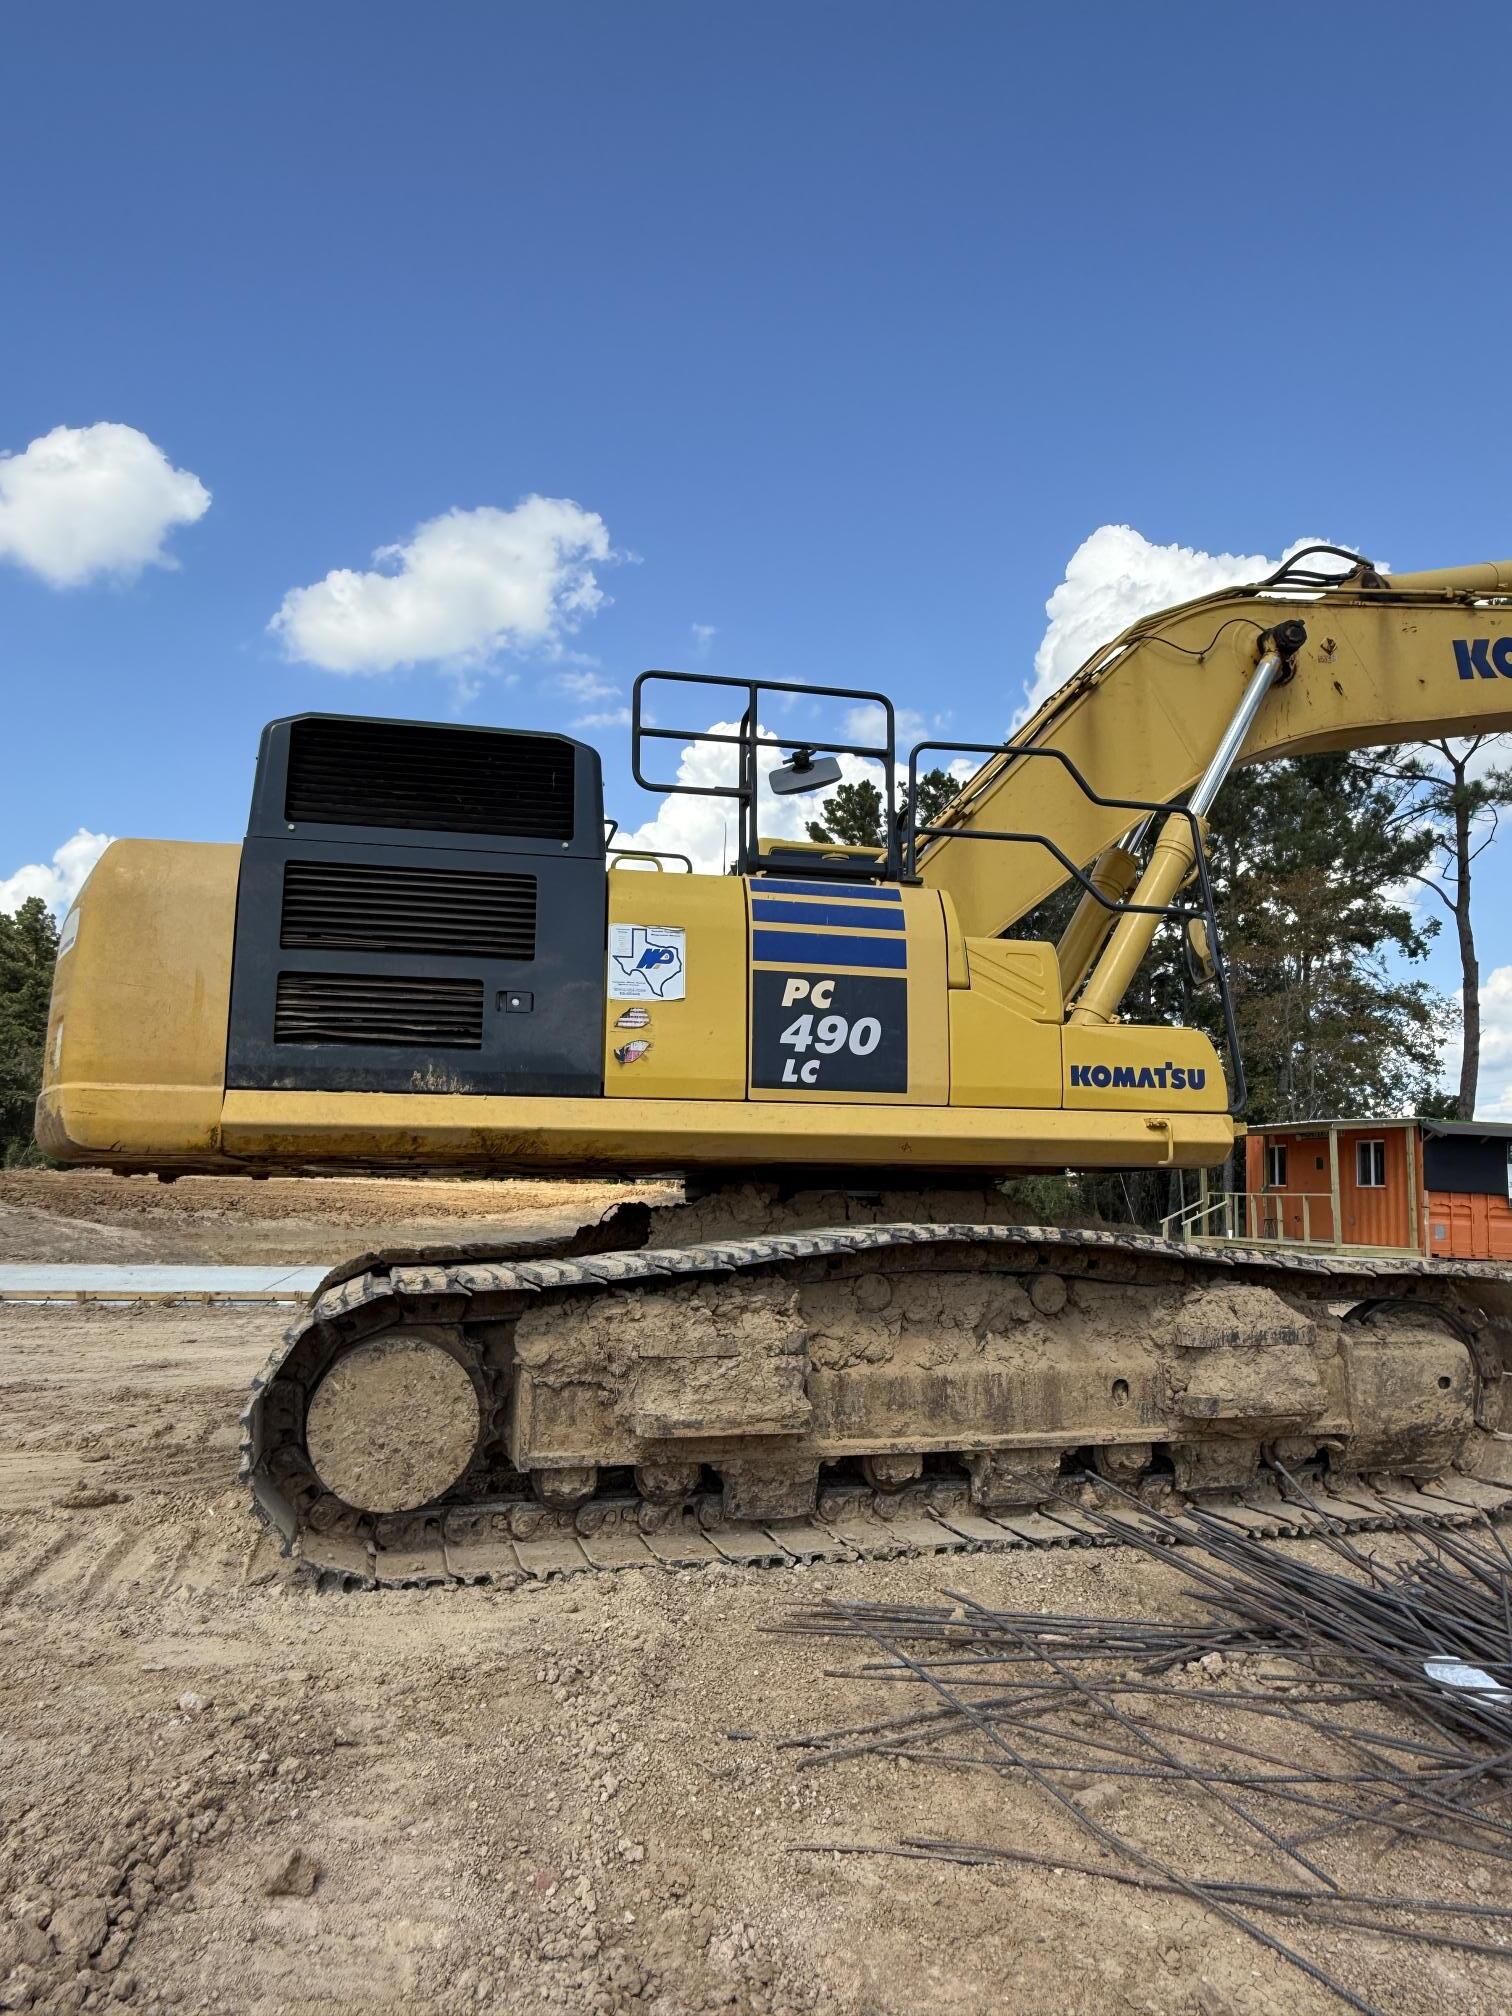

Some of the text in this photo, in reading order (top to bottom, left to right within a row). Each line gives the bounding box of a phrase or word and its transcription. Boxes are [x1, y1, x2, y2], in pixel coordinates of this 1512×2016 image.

[781, 978, 836, 1009] PC
[779, 1014, 882, 1056] 490
[781, 1058, 821, 1084] LC
[1071, 1062, 1205, 1089] KOMATSU
